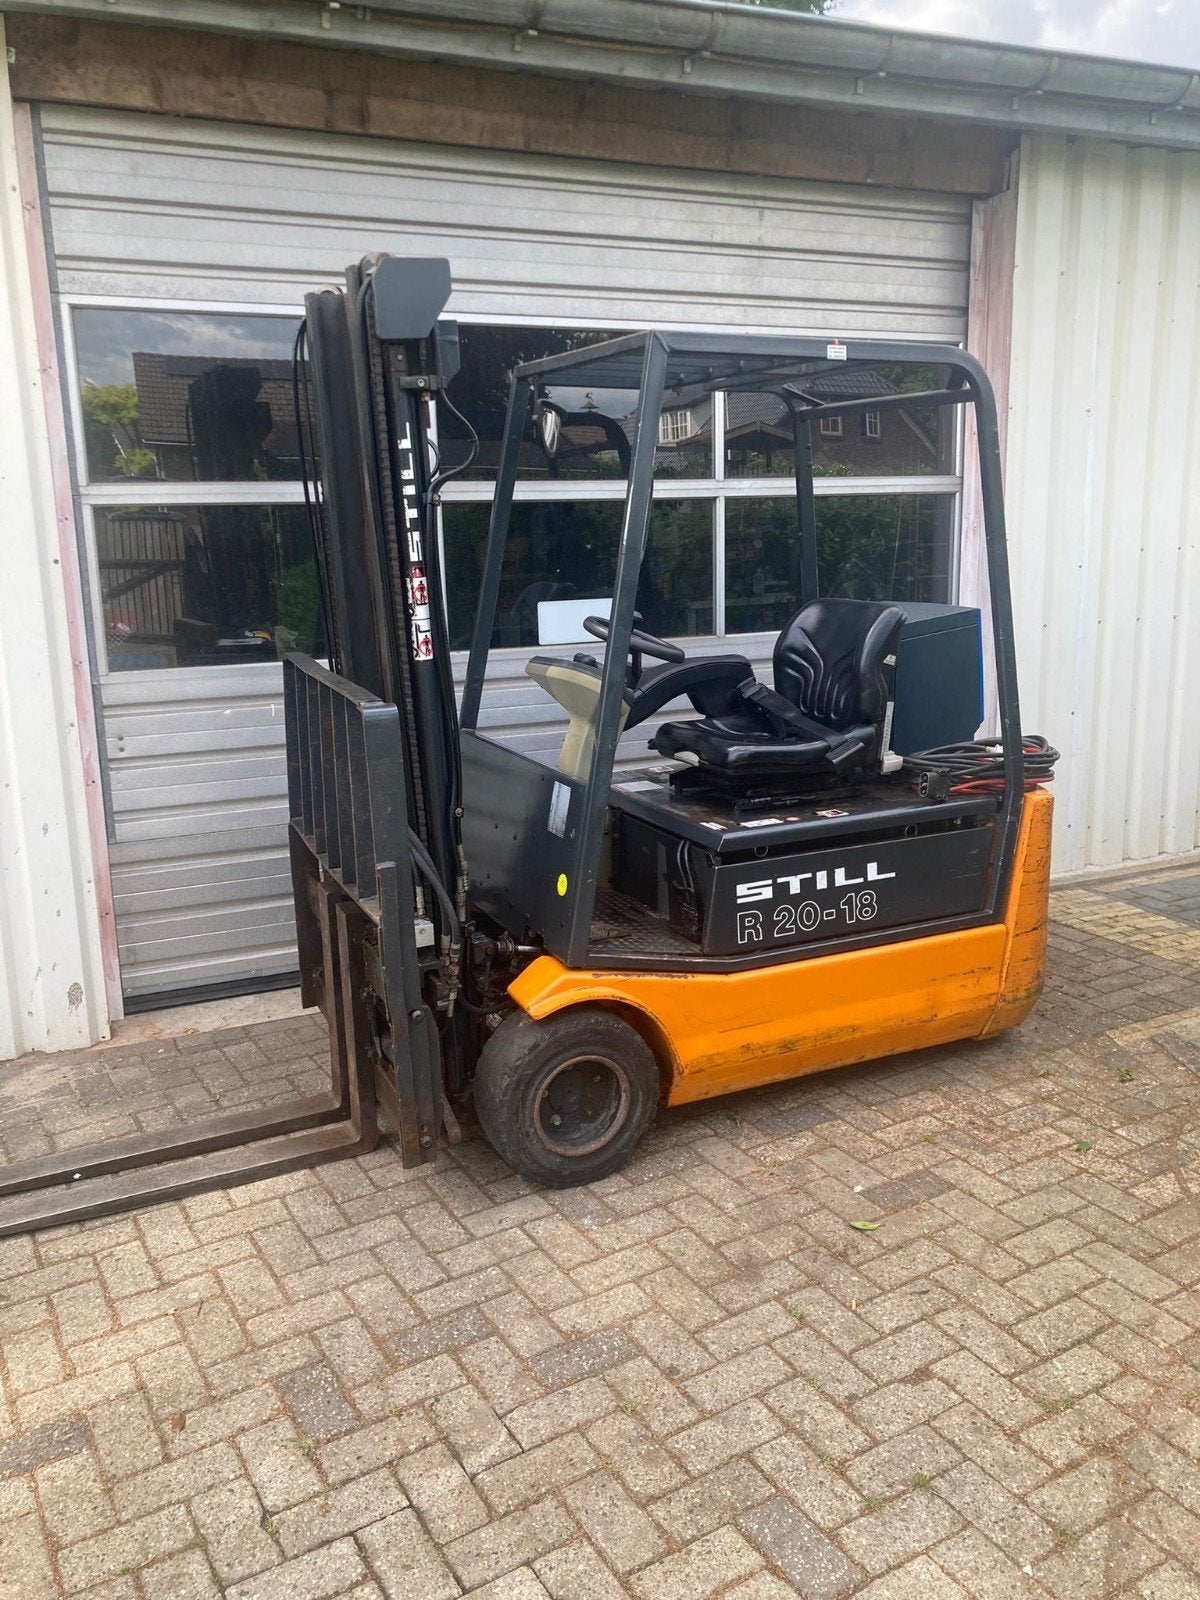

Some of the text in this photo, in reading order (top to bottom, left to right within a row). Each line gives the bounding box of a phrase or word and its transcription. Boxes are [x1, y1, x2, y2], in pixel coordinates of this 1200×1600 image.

[398, 422, 422, 561] STILL
[736, 862, 896, 904] STILL
[737, 890, 878, 944] R 20-18
